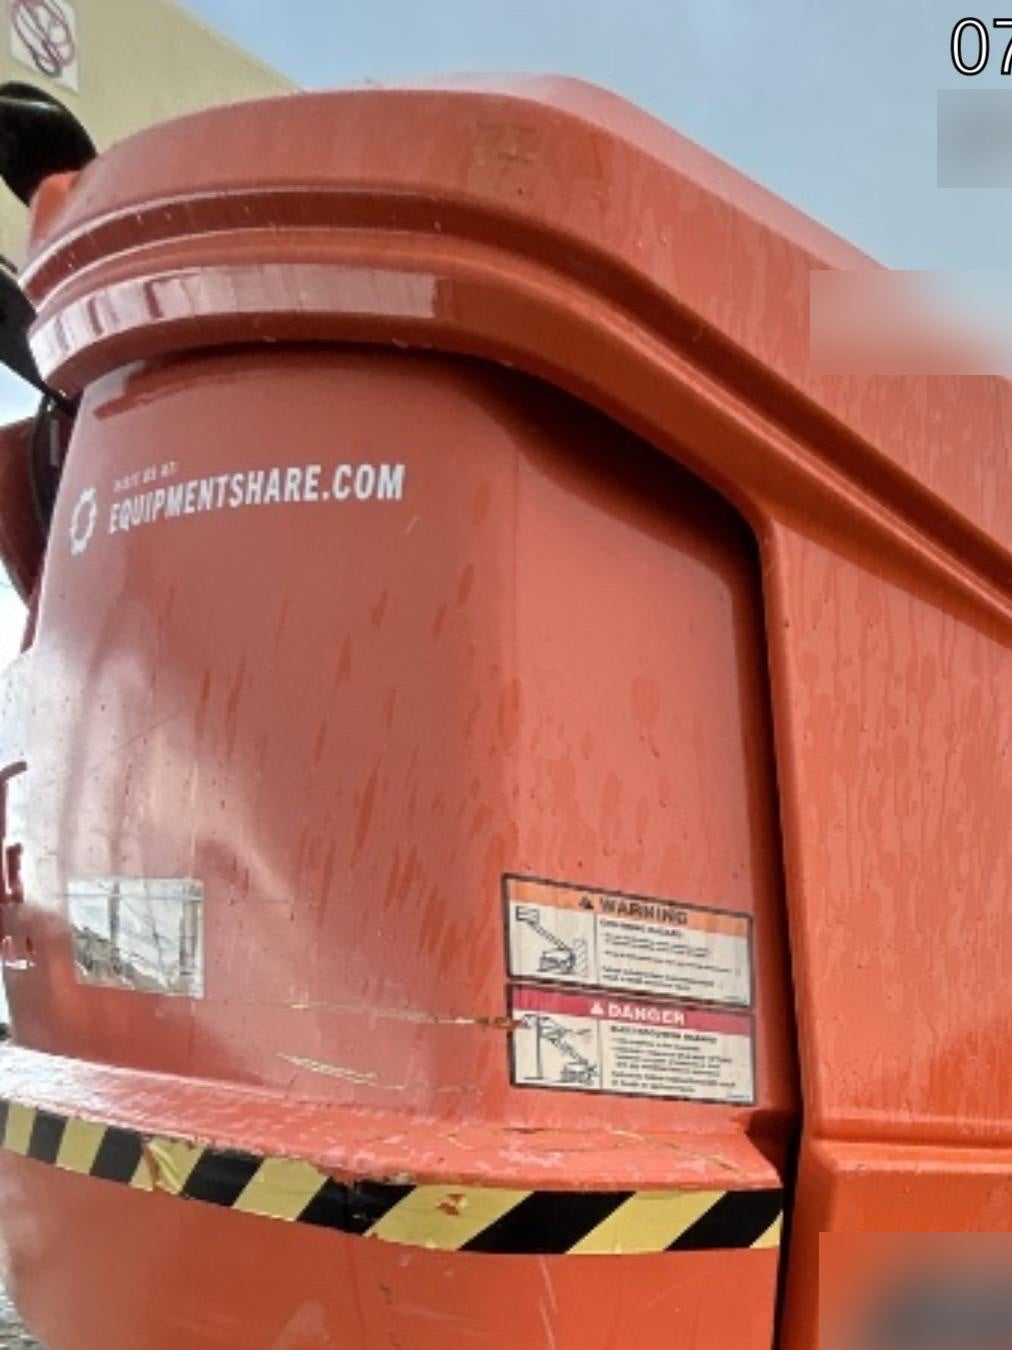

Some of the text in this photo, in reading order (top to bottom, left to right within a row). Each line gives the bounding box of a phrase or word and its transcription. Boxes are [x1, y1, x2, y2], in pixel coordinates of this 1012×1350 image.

[108, 463, 405, 535] EQUIPMENTSHARE.COM
[599, 896, 688, 925] WARNING
[607, 1002, 685, 1026] DANGER
